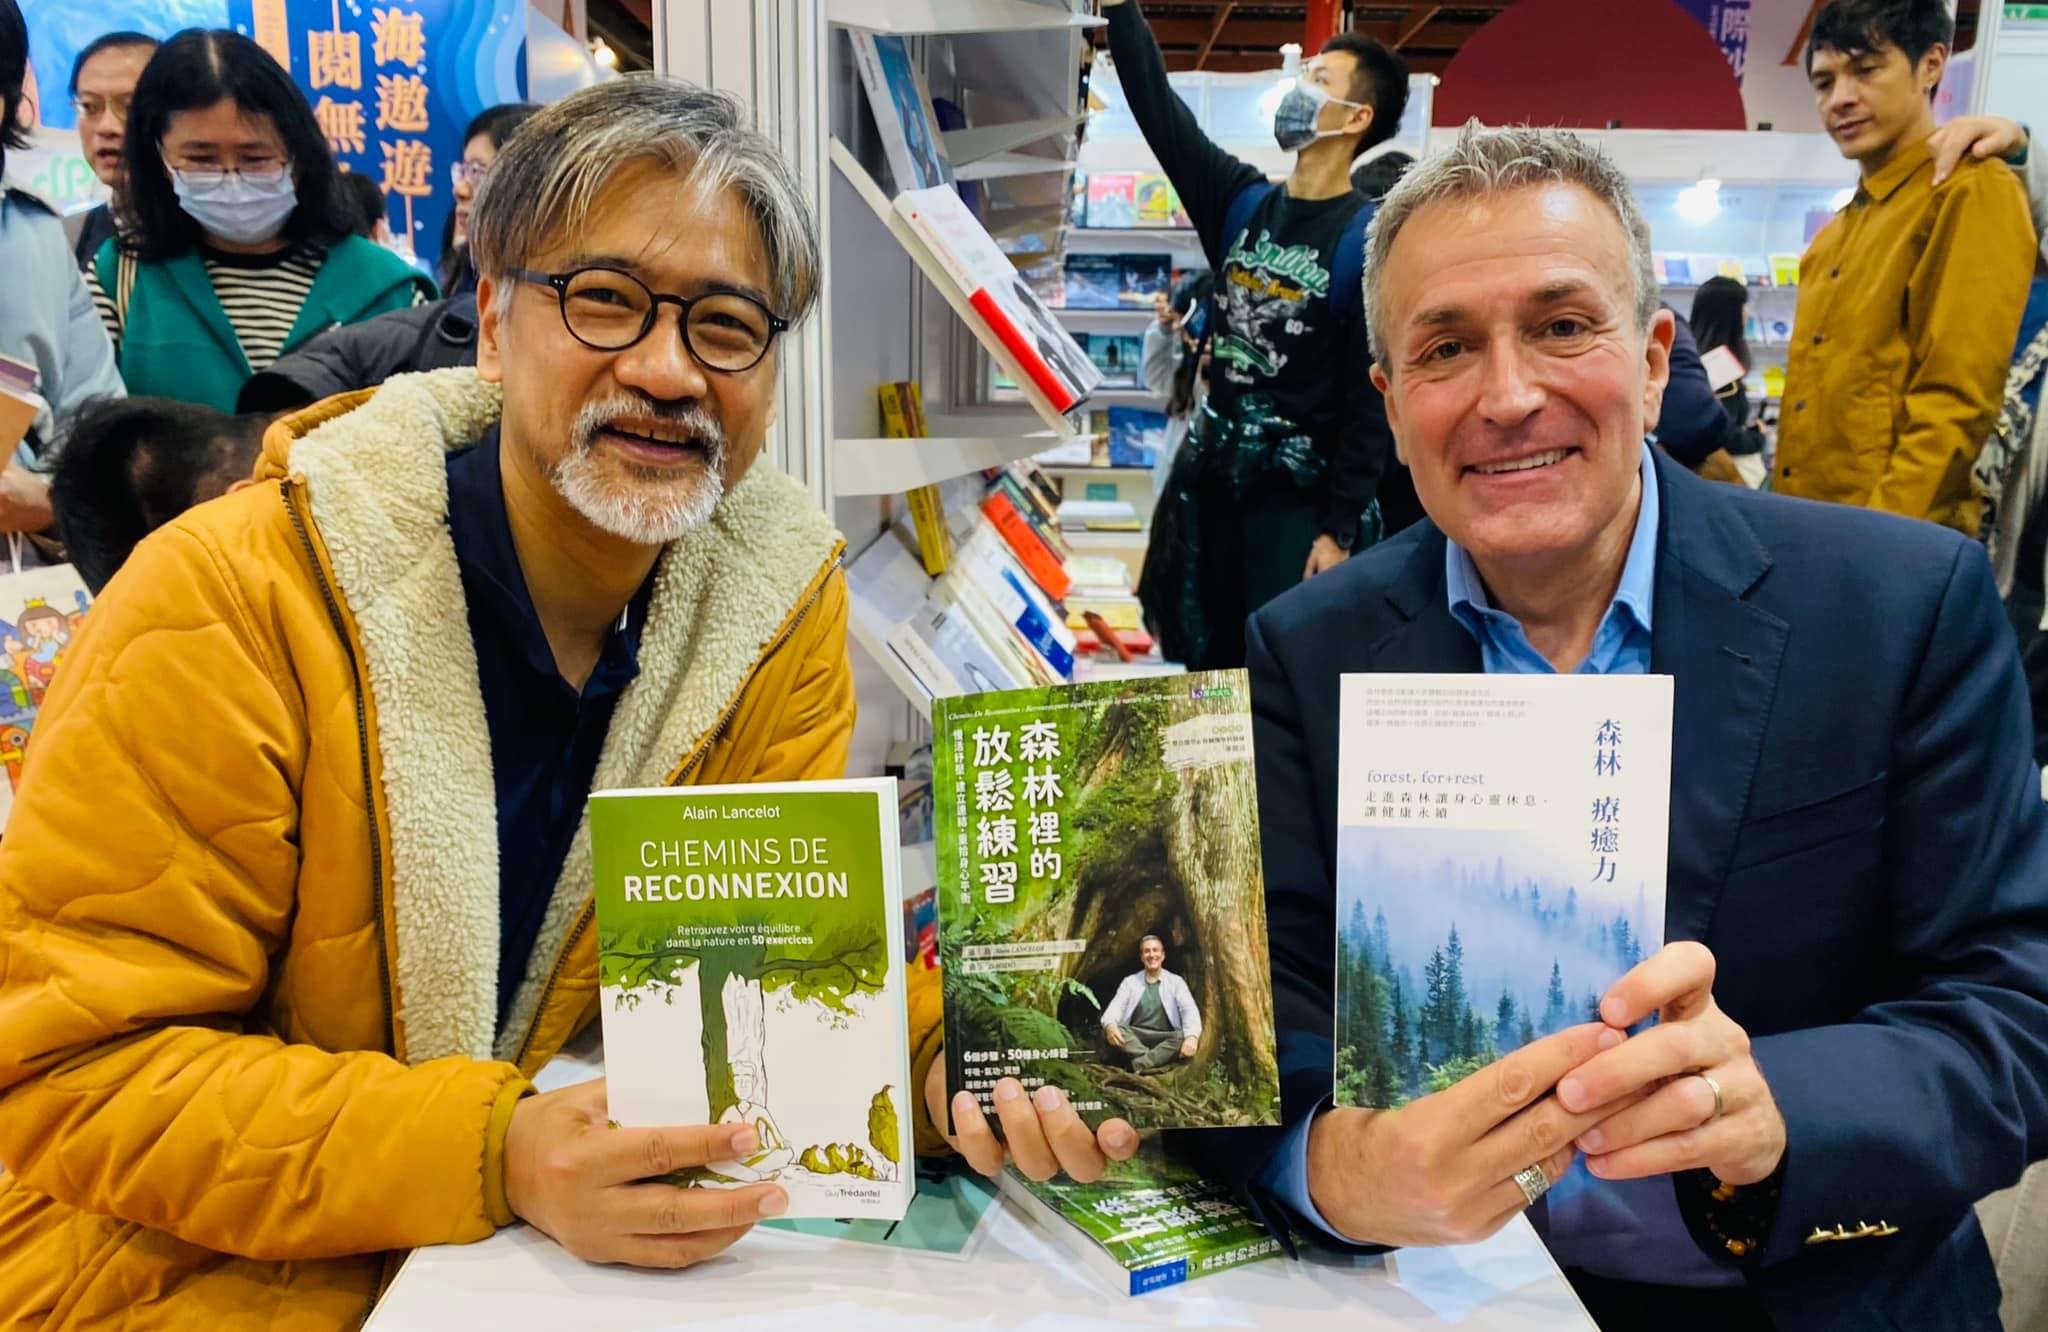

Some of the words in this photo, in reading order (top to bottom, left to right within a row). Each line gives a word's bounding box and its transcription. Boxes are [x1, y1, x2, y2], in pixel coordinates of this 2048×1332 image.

[1594, 719, 1622, 776] 森林
[1367, 770, 1417, 784] forest,
[1421, 770, 1486, 785] for+rest
[683, 806, 717, 821] Alain
[722, 805, 780, 820] Lancelot
[972, 723, 1019, 904] 放鬆練習
[1019, 718, 1064, 880] 森林裡的
[640, 838, 781, 868] CHEMINS
[791, 837, 829, 865] DE
[1591, 796, 1620, 882] 療癒力
[624, 871, 848, 902] RECONNEXION
[666, 938, 690, 948] dans
[692, 937, 701, 947] la
[703, 937, 735, 947] nature
[737, 936, 750, 945] en
[752, 935, 764, 945] 50
[766, 934, 813, 945] exercices
[677, 925, 728, 936] Retrouvez
[730, 924, 755, 935] votre
[757, 923, 801, 935] équilibre
